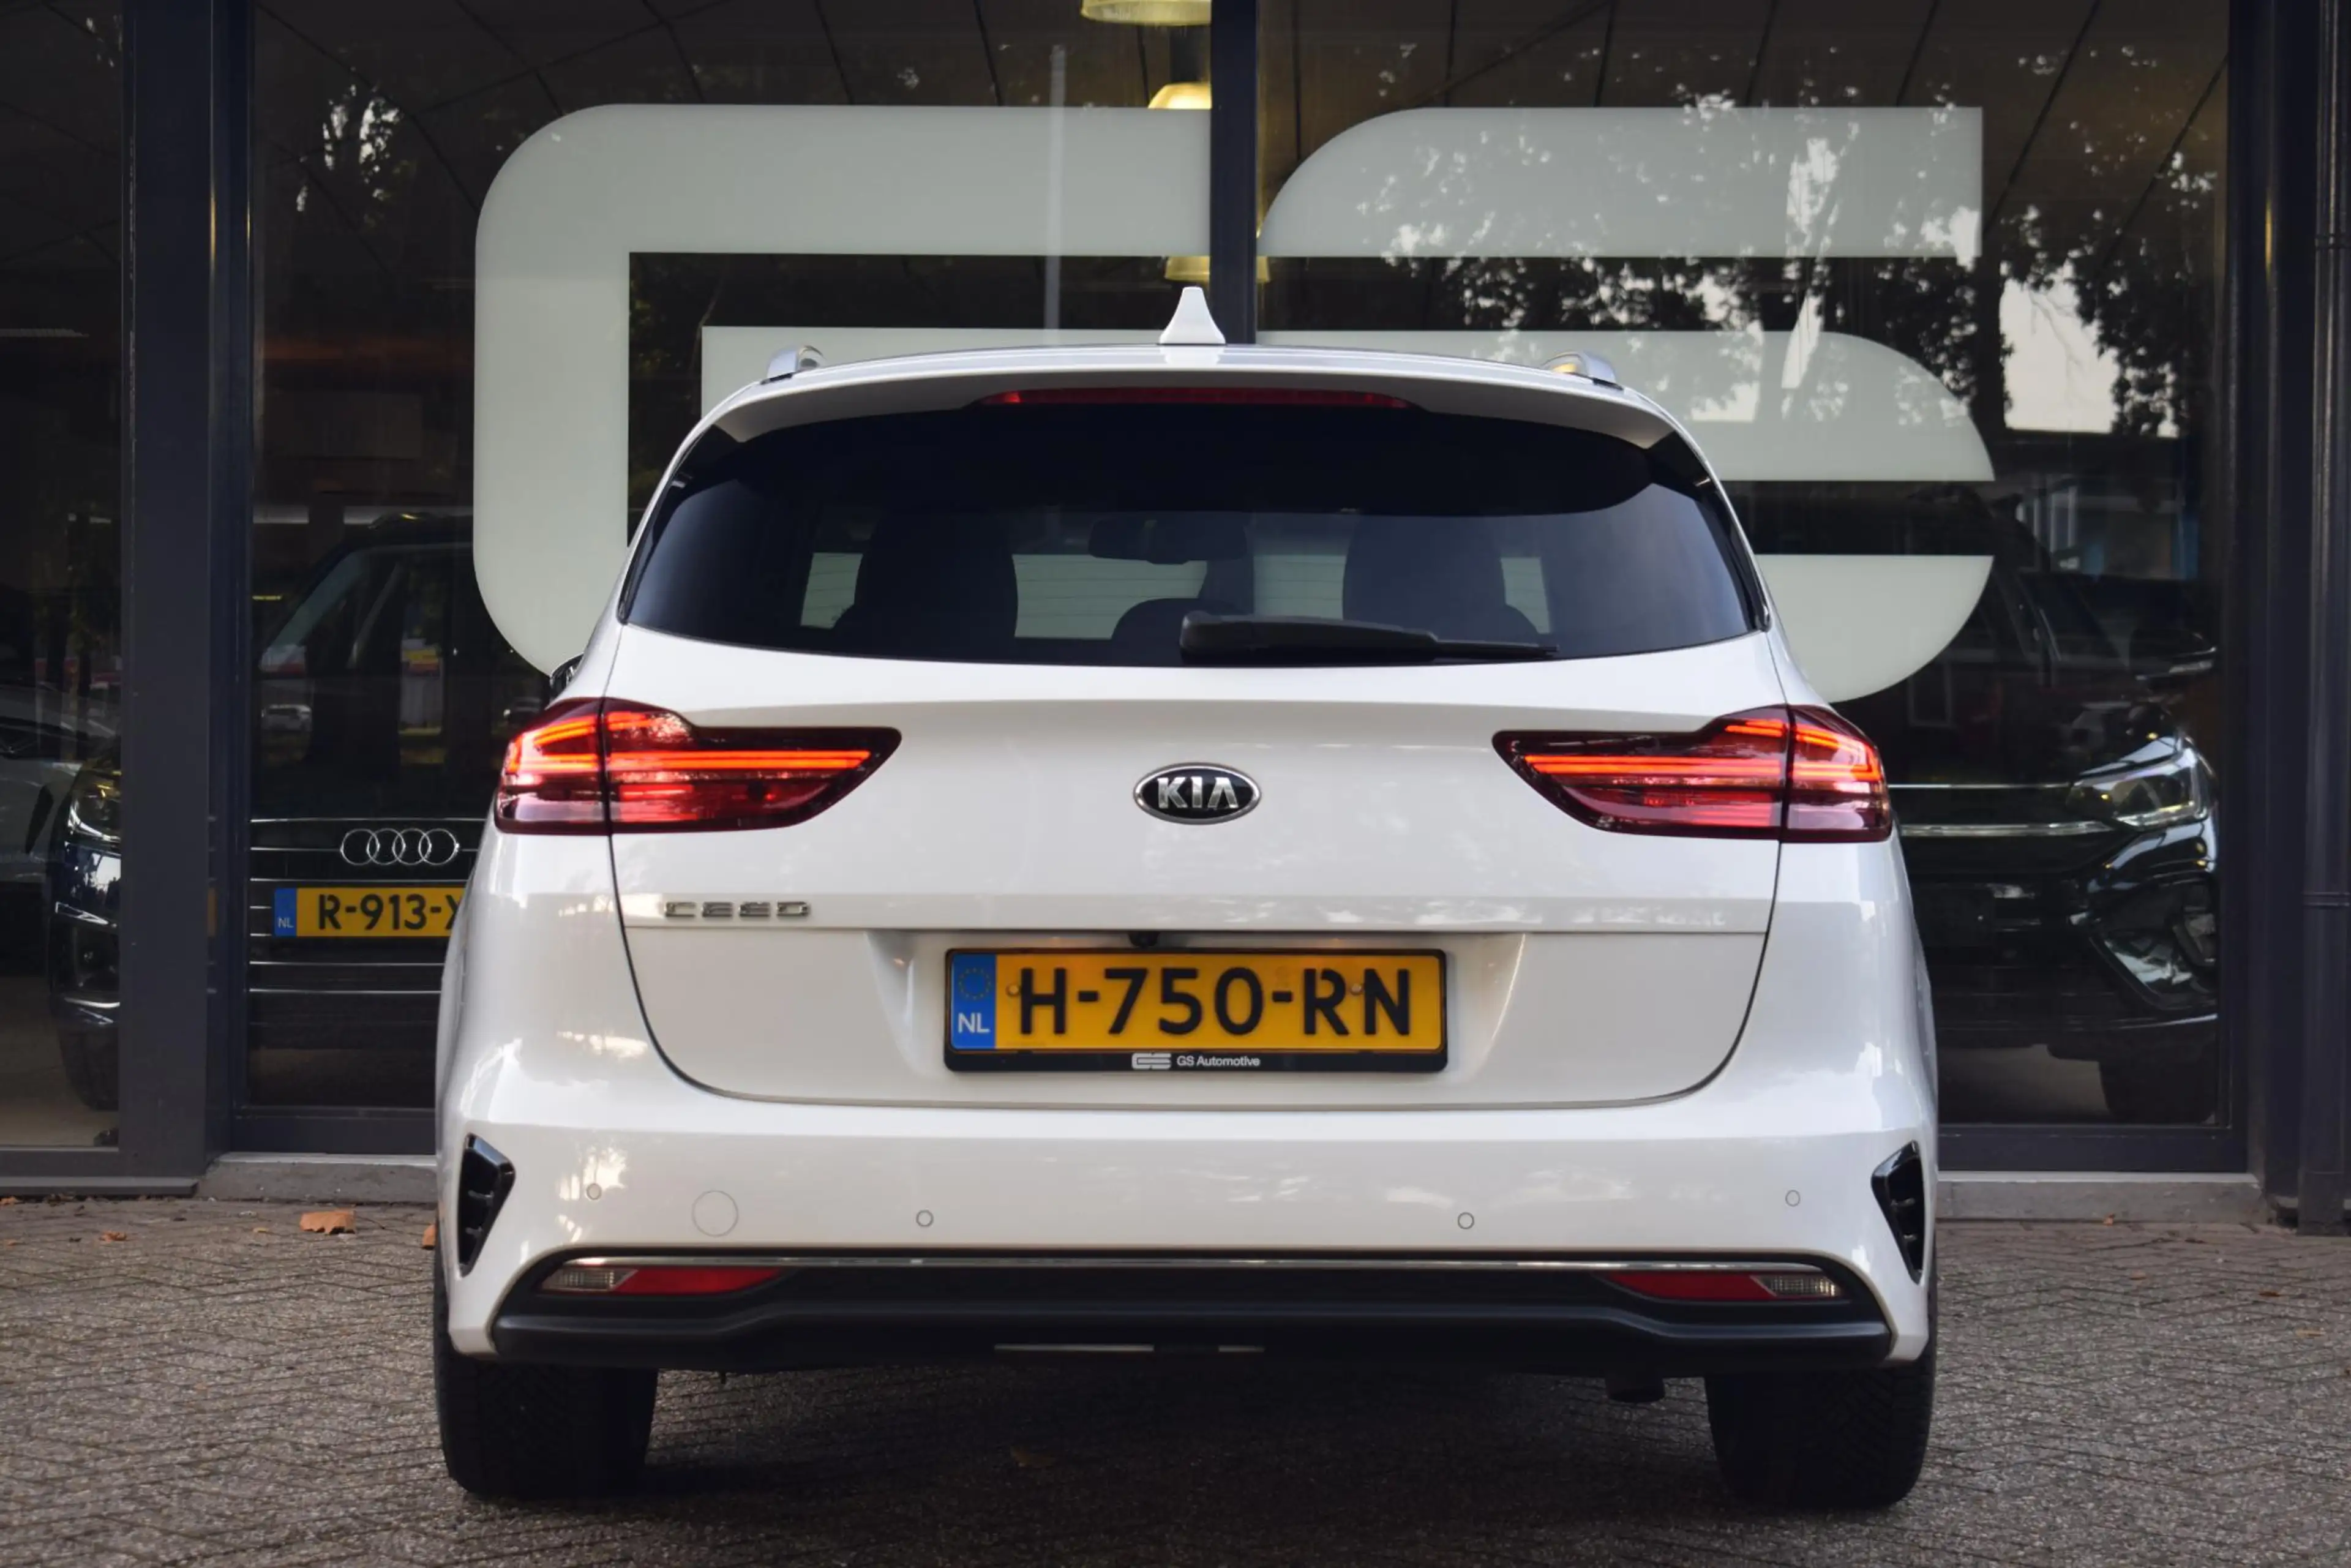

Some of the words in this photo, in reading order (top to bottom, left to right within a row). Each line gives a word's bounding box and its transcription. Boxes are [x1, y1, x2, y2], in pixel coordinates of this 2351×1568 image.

[1157, 776, 1239, 808] KIA
[277, 917, 294, 929] NL
[1020, 967, 1411, 1036] H-750-RN
[958, 1012, 991, 1034] NL
[1176, 1055, 1194, 1067] GS
[1196, 1055, 1261, 1067] Automotive
